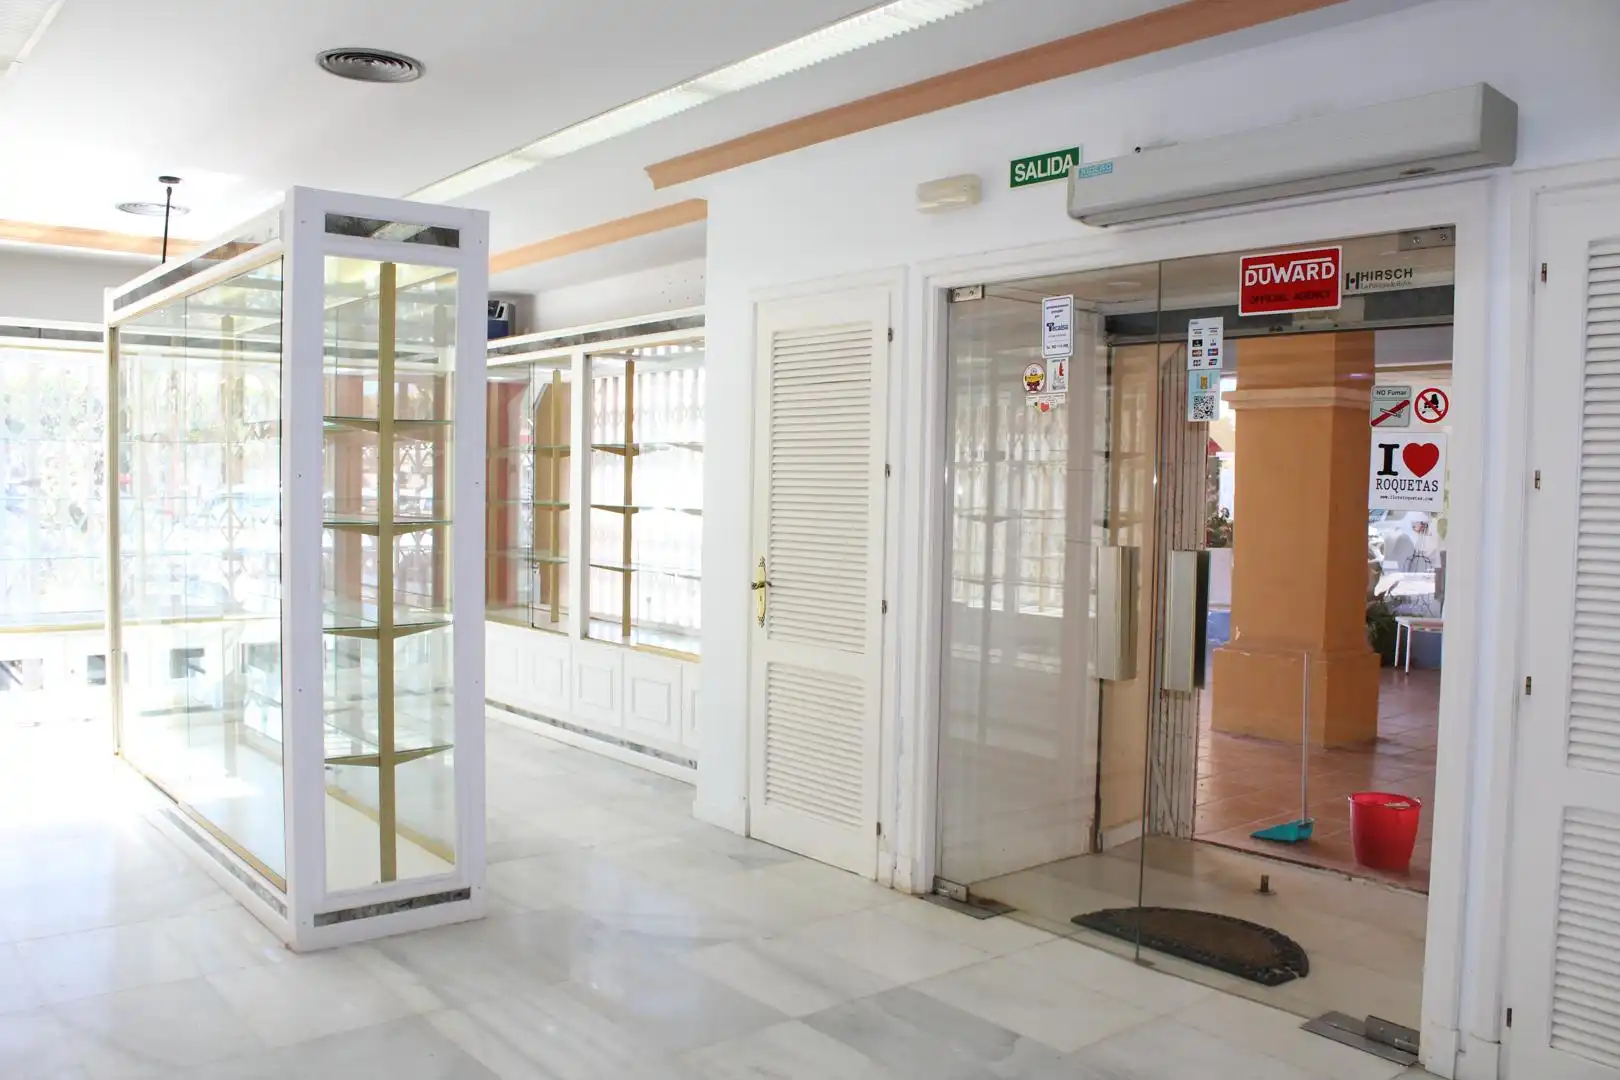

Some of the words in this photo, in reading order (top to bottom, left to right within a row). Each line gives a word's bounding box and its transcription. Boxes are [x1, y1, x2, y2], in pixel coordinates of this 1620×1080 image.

[1015, 154, 1073, 182] SALIDA
[1245, 257, 1335, 287] DUWARD
[1361, 268, 1413, 282] HIRSCH
[1377, 443, 1400, 476] I
[1375, 478, 1439, 493] ROQUETAS
